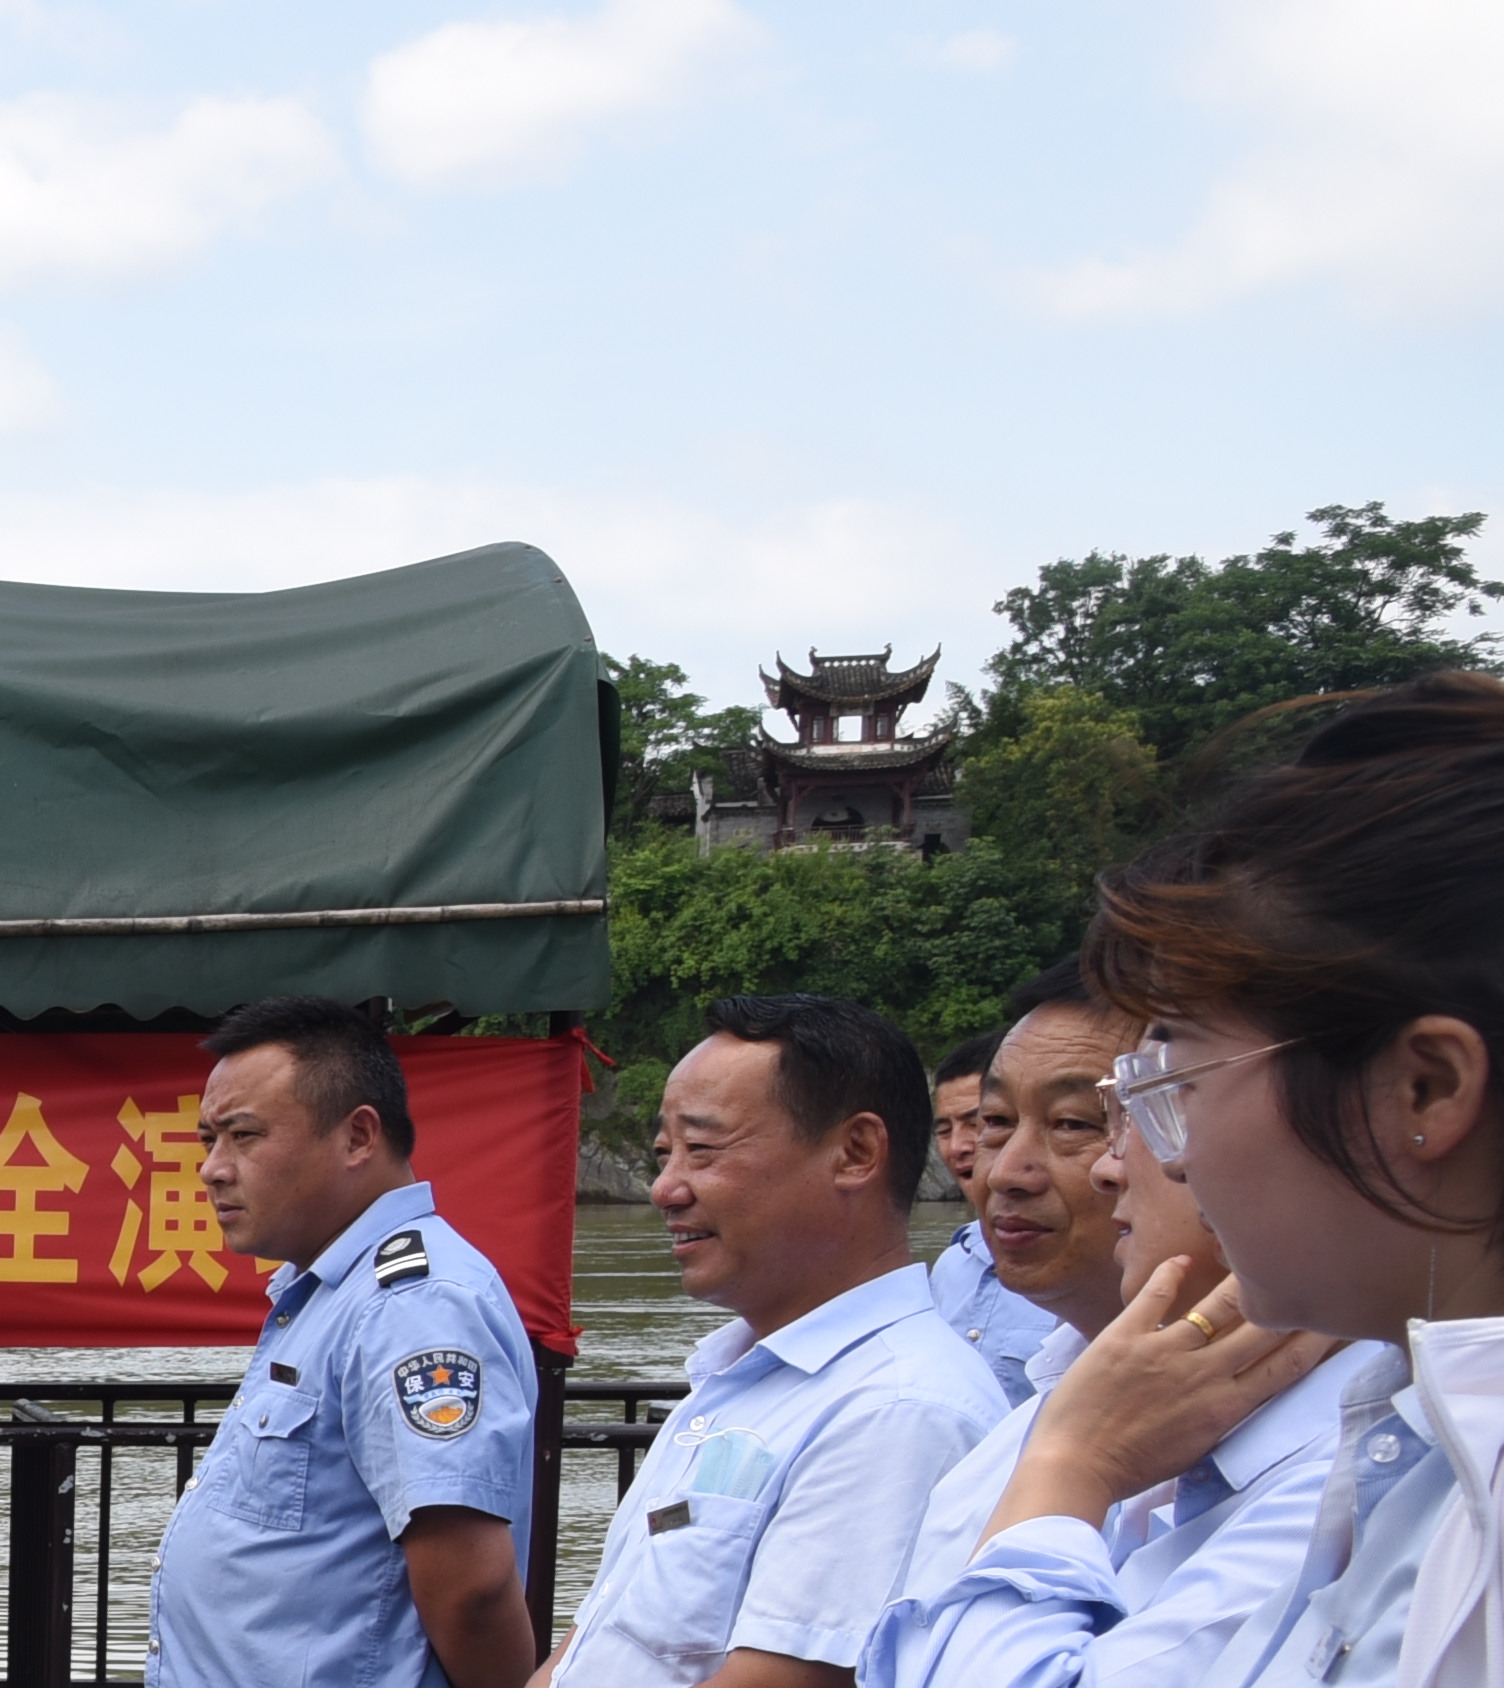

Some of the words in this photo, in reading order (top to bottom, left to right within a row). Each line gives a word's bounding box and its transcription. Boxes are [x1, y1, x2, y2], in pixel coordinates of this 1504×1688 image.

[398, 1352, 477, 1378] 中华人民共和国
